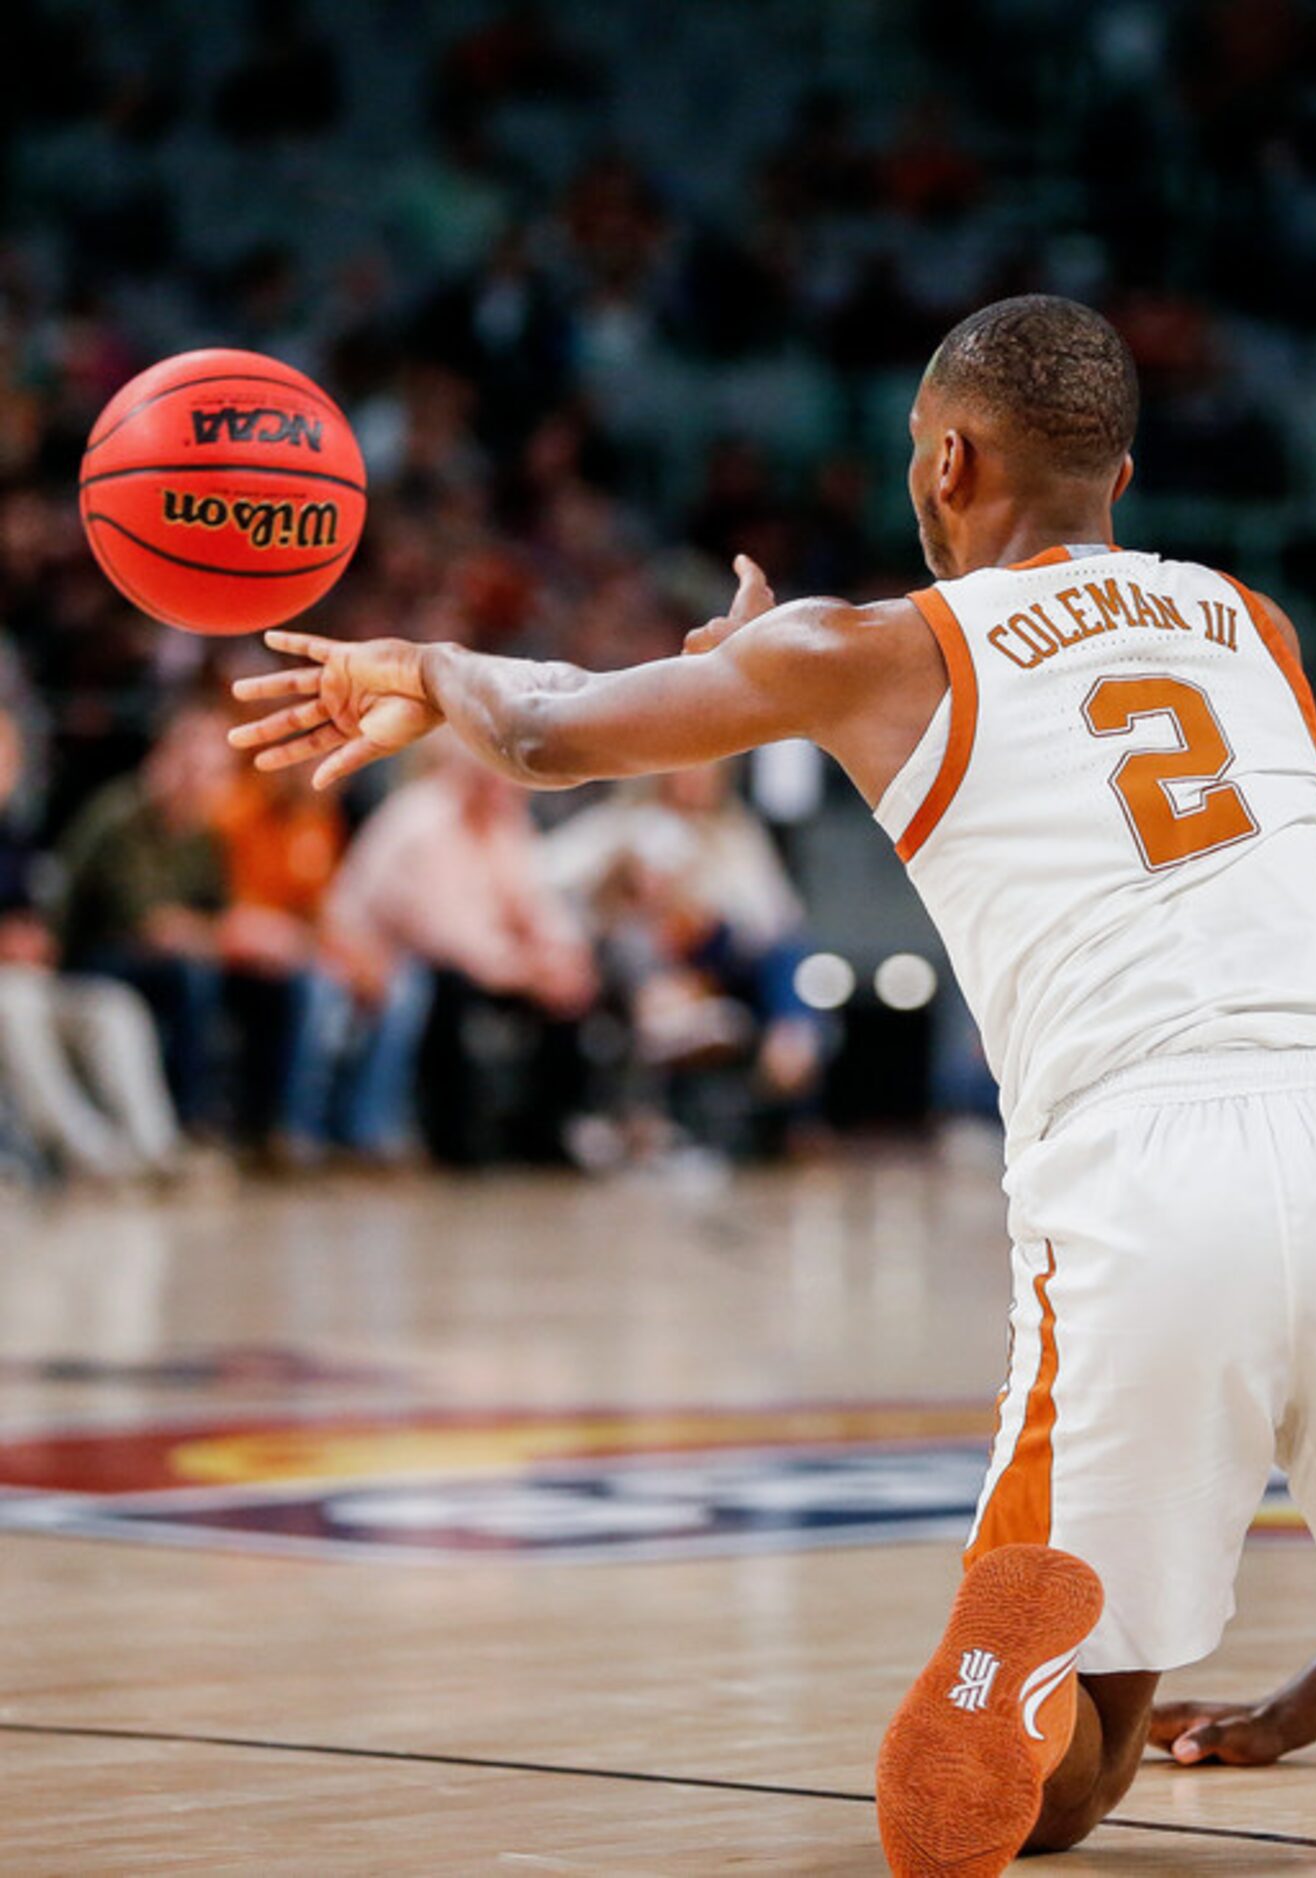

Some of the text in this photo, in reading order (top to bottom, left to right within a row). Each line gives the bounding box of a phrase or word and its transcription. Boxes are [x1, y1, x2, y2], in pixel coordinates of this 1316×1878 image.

[191, 408, 322, 453] NCAA
[161, 489, 338, 548] Wilson
[987, 578, 1238, 669] COLEMAN III
[1080, 673, 1260, 873] 2
